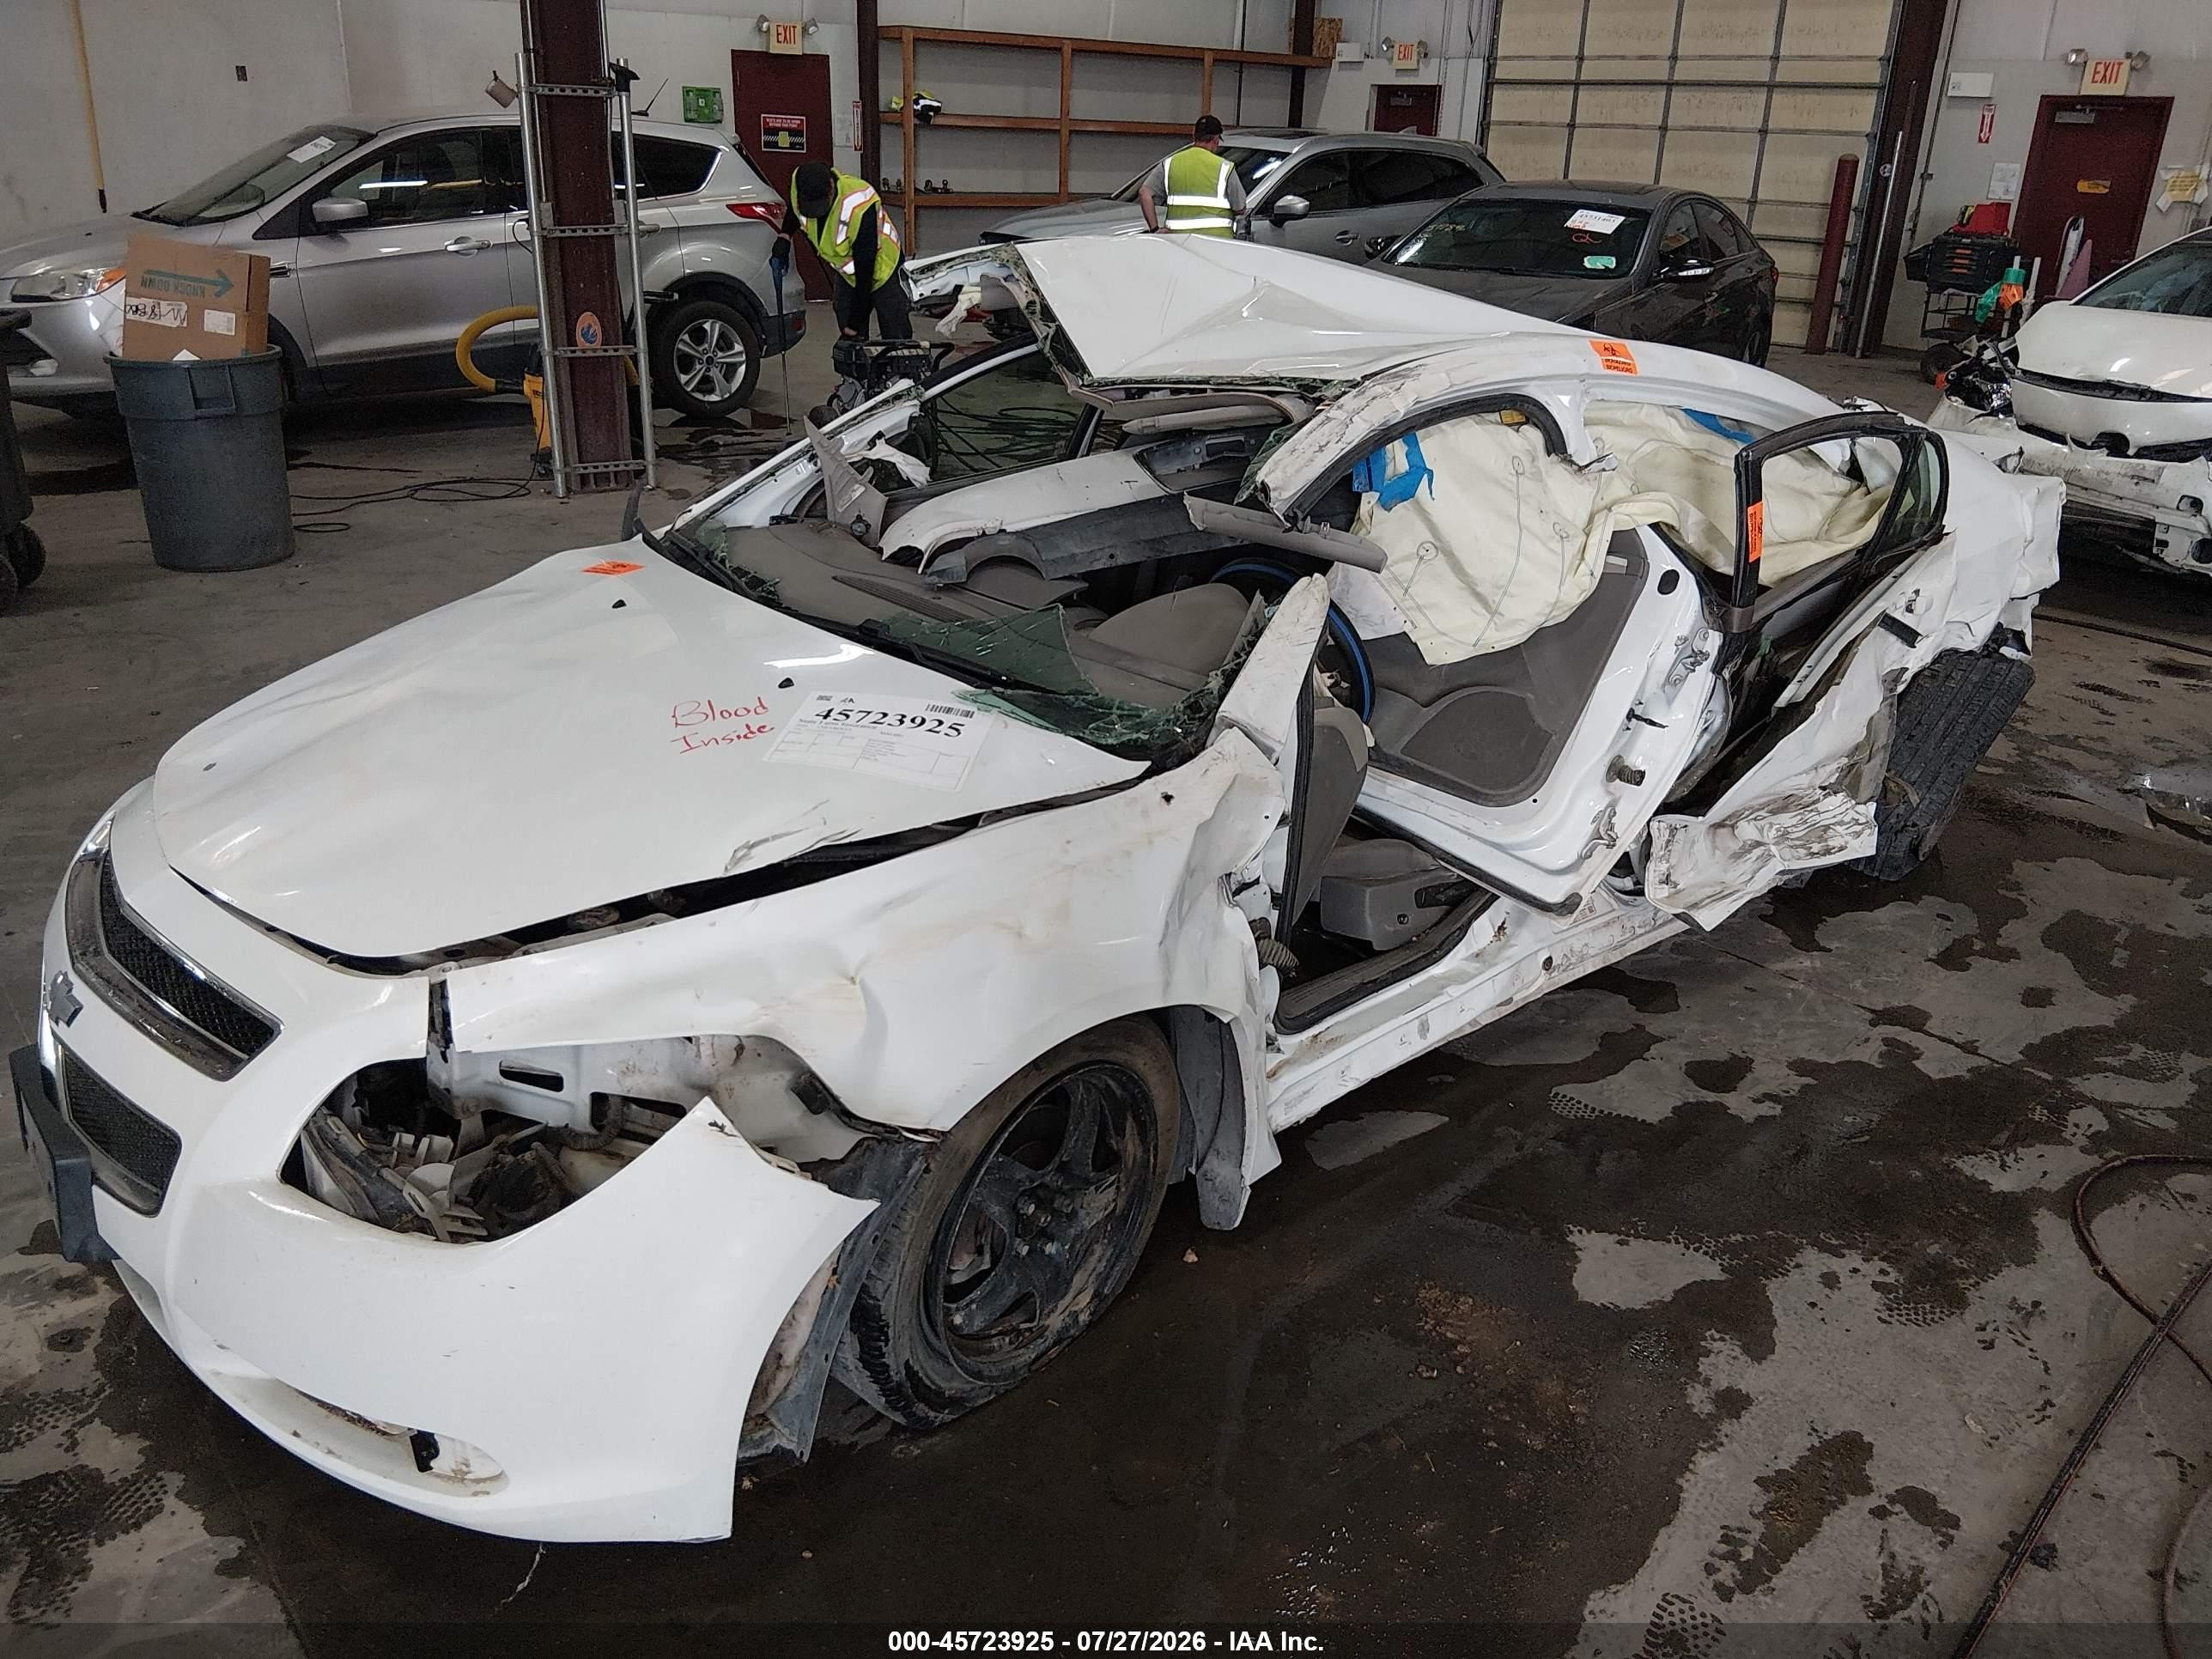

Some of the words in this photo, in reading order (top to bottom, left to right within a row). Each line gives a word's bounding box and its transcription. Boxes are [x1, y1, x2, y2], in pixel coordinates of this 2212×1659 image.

[775, 24, 797, 45] EXIT
[1398, 44, 1414, 61] EXIT
[2091, 61, 2124, 83] EXIT
[140, 275, 170, 292] DOWN
[173, 281, 206, 298] KNOCK
[671, 696, 769, 728] Blood
[814, 708, 966, 738] 45723925
[671, 723, 775, 755] Inside
